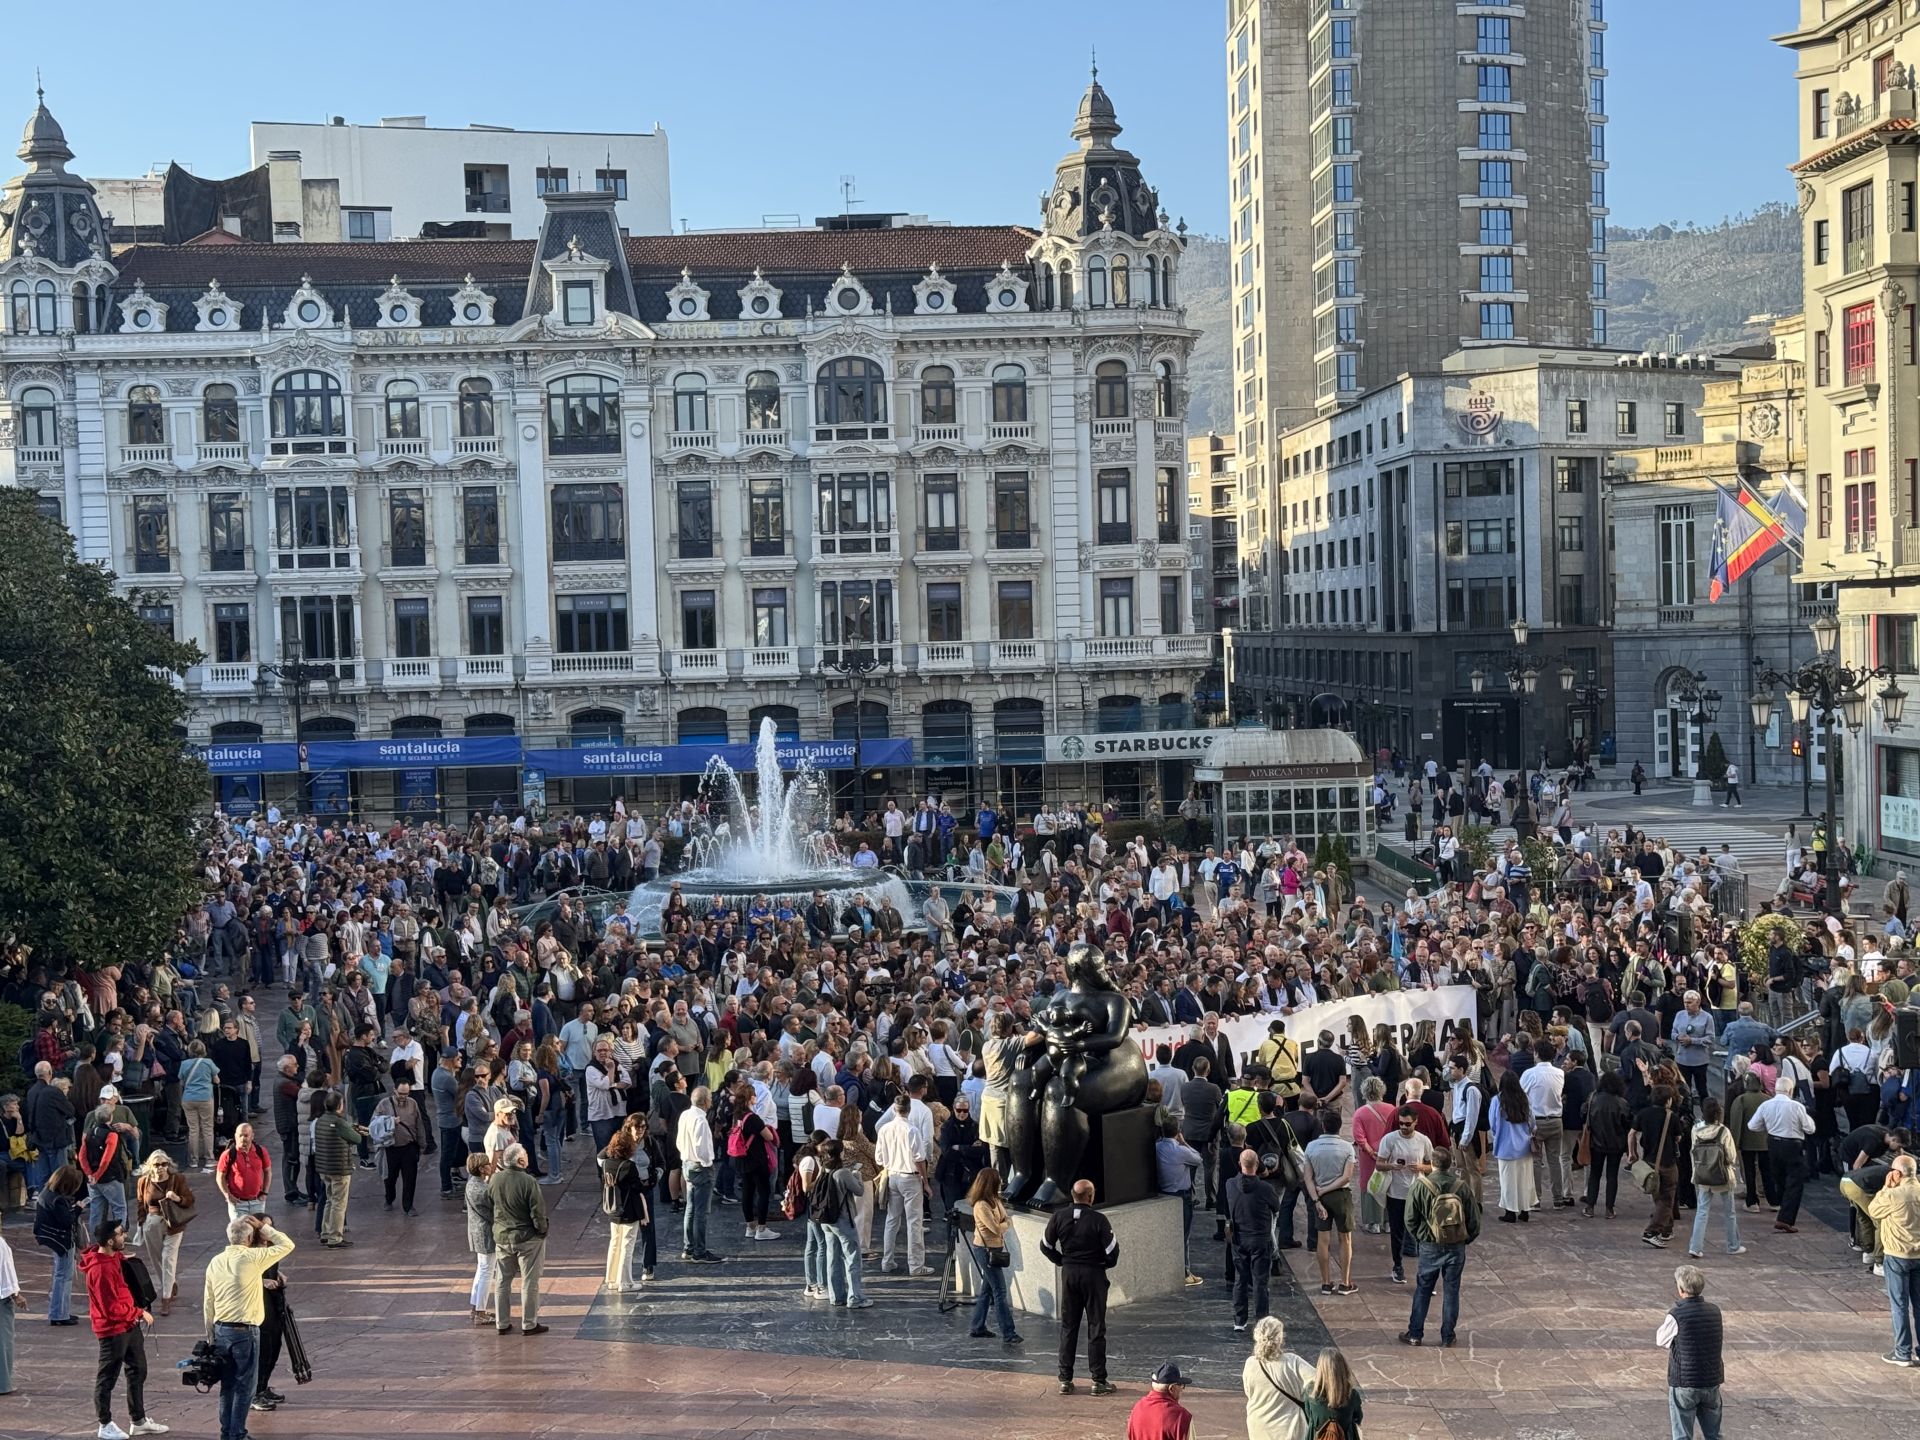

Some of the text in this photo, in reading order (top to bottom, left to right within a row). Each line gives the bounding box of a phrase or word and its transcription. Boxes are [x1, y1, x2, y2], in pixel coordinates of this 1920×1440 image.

[379, 741, 460, 755] santalucía
[778, 744, 856, 758] santalucía
[1094, 735, 1214, 754] STARBUCKS
[583, 750, 663, 764] santalucía
